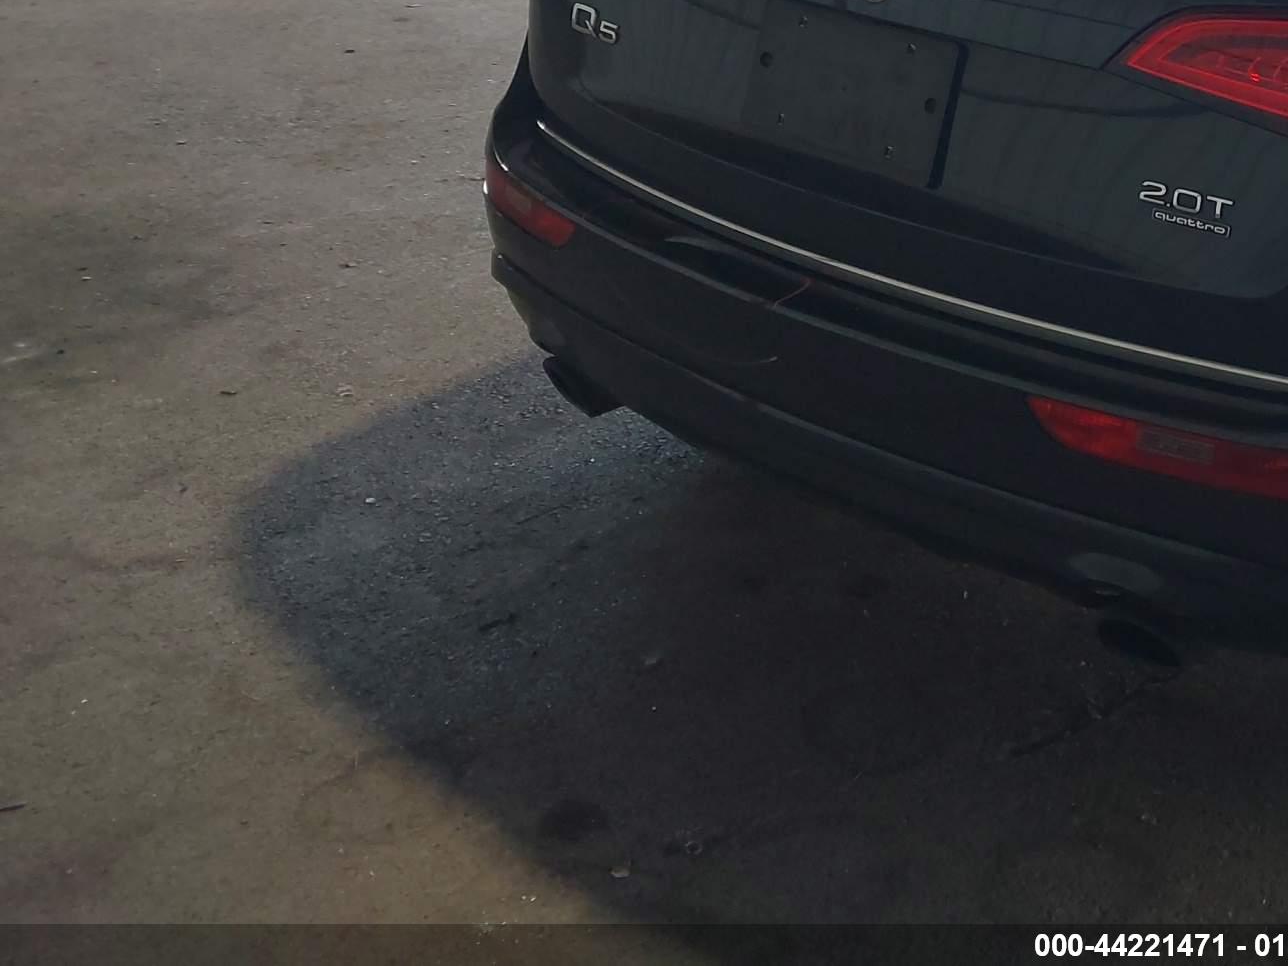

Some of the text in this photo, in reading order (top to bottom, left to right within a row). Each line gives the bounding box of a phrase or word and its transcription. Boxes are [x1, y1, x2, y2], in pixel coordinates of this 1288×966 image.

[571, 2, 618, 44] Q5
[1139, 181, 1234, 219] 2.0T
[1154, 211, 1226, 235] quattro
